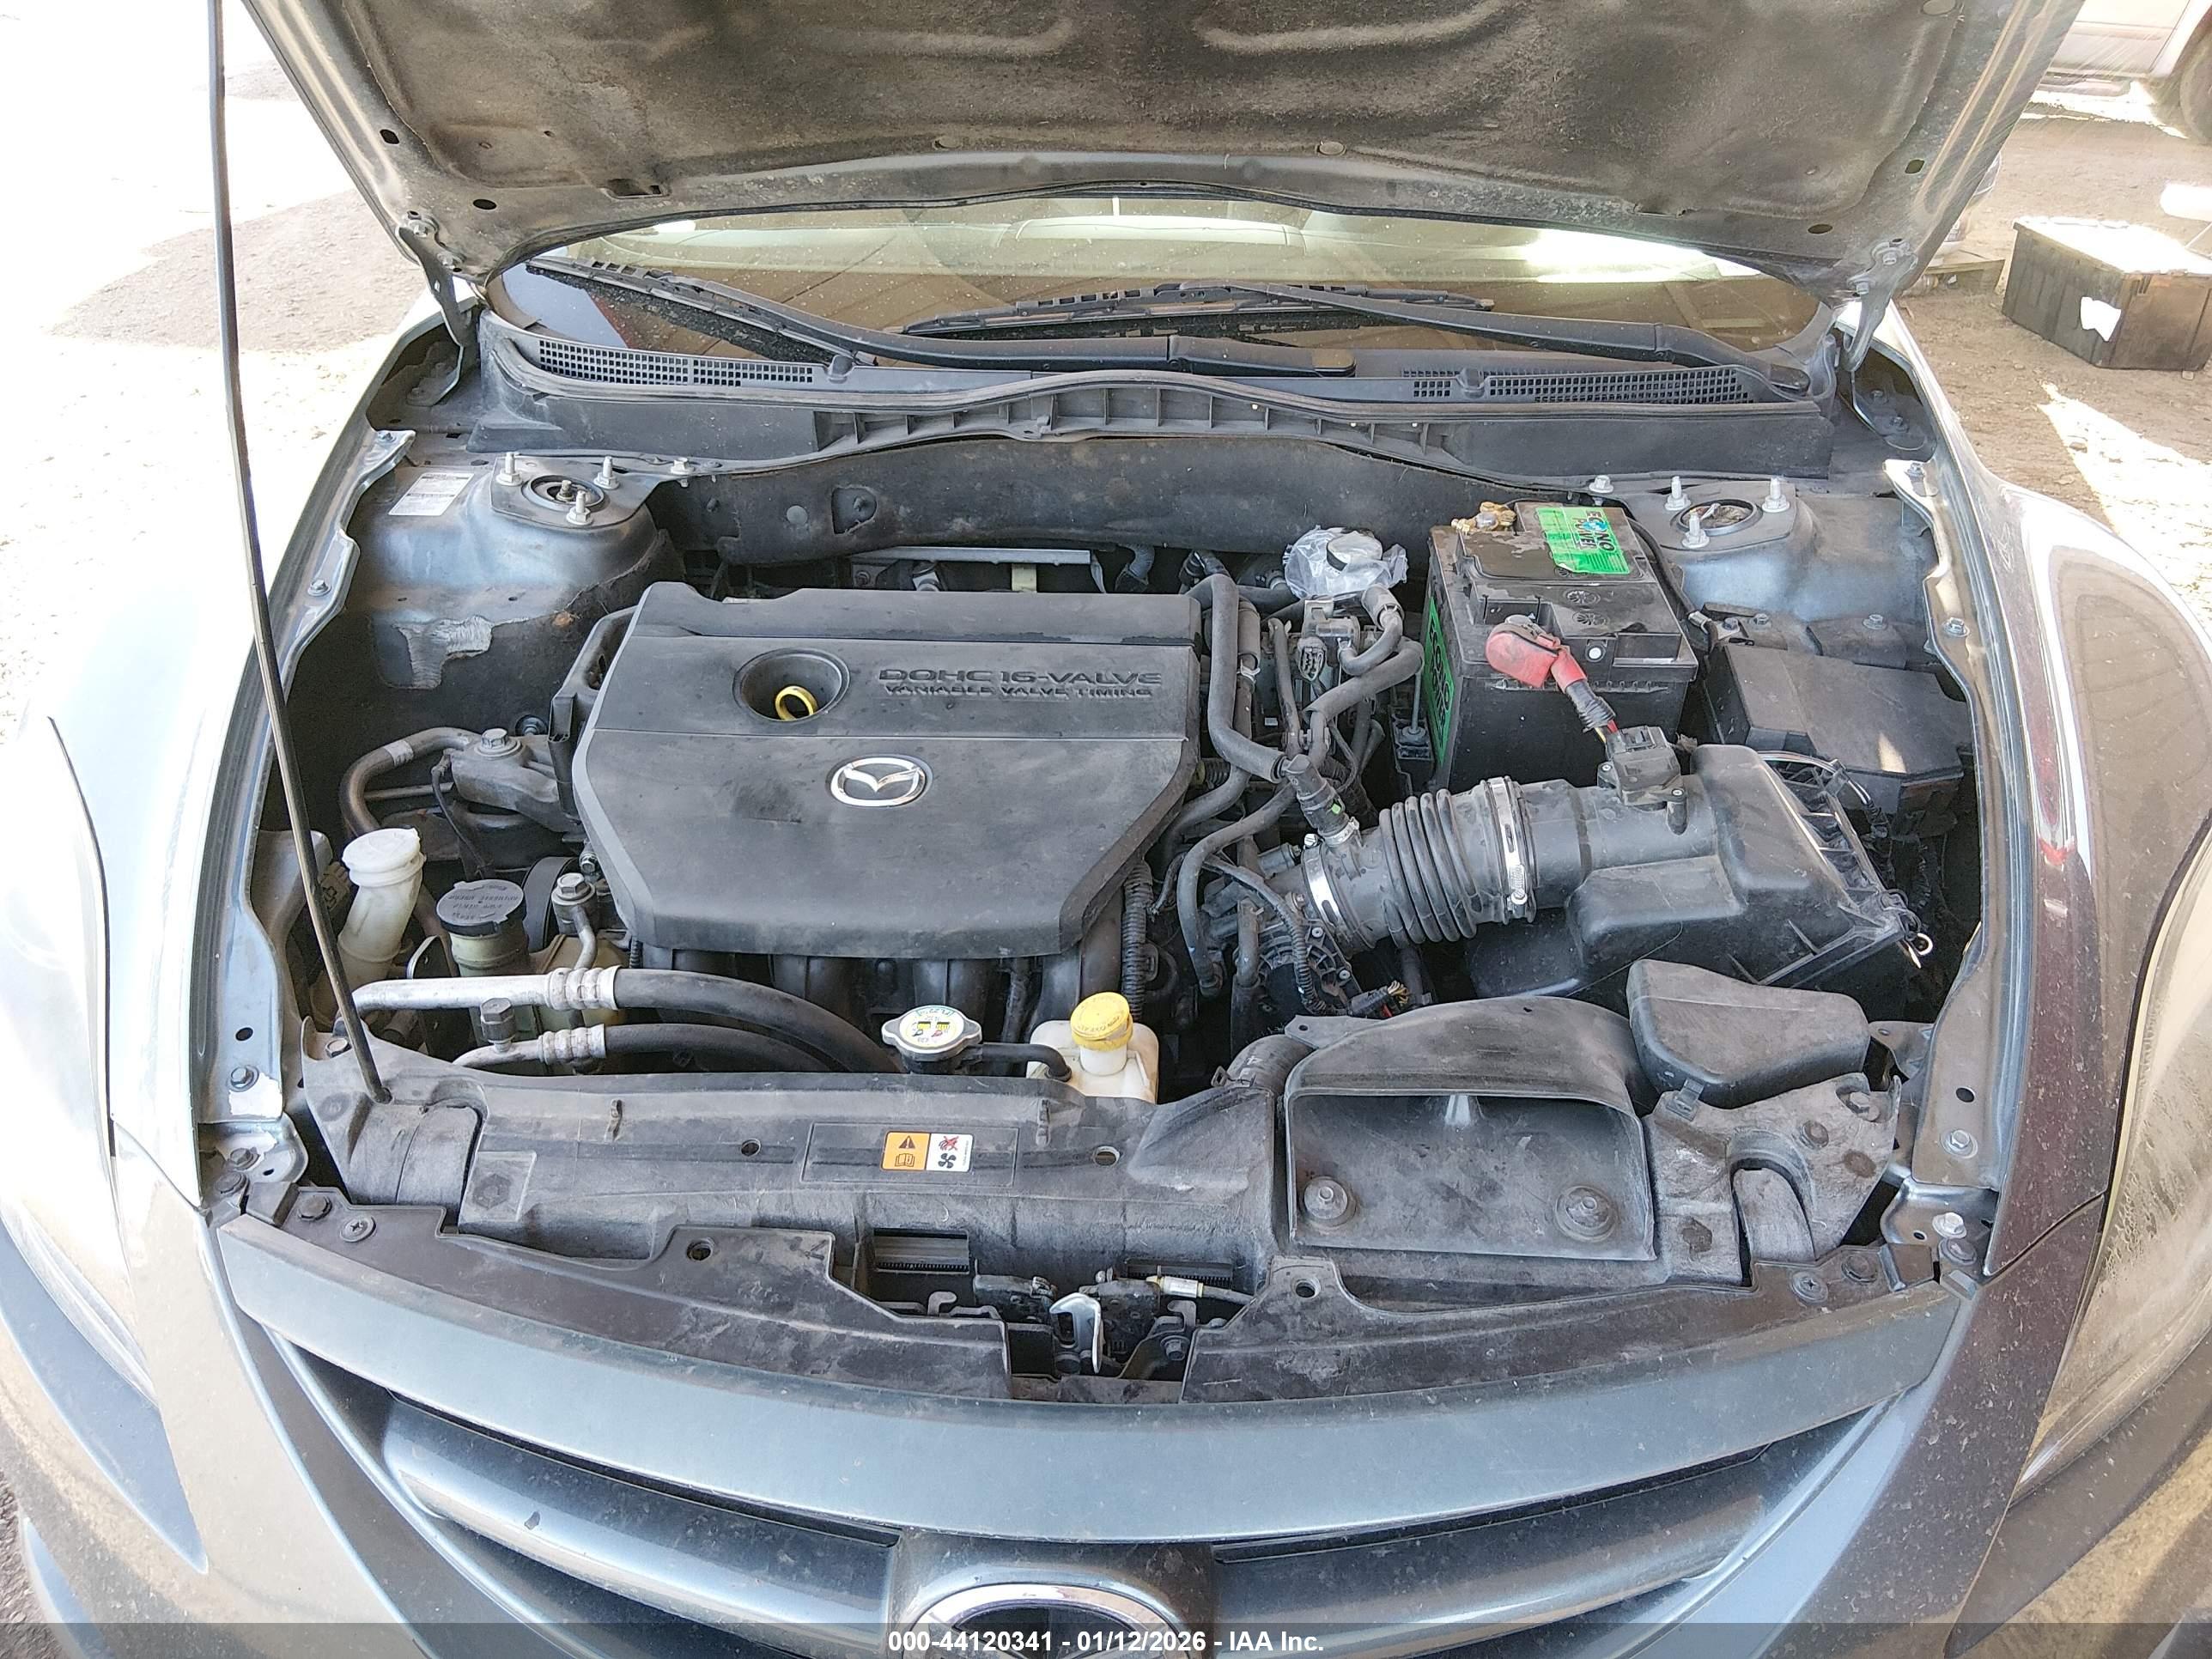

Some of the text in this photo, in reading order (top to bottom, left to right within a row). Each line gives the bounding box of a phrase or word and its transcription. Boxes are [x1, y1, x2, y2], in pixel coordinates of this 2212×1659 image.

[878, 668, 1162, 685] DOHC 16-VALVE
[884, 686, 1152, 699] VARIABLE VALVE TIMING
